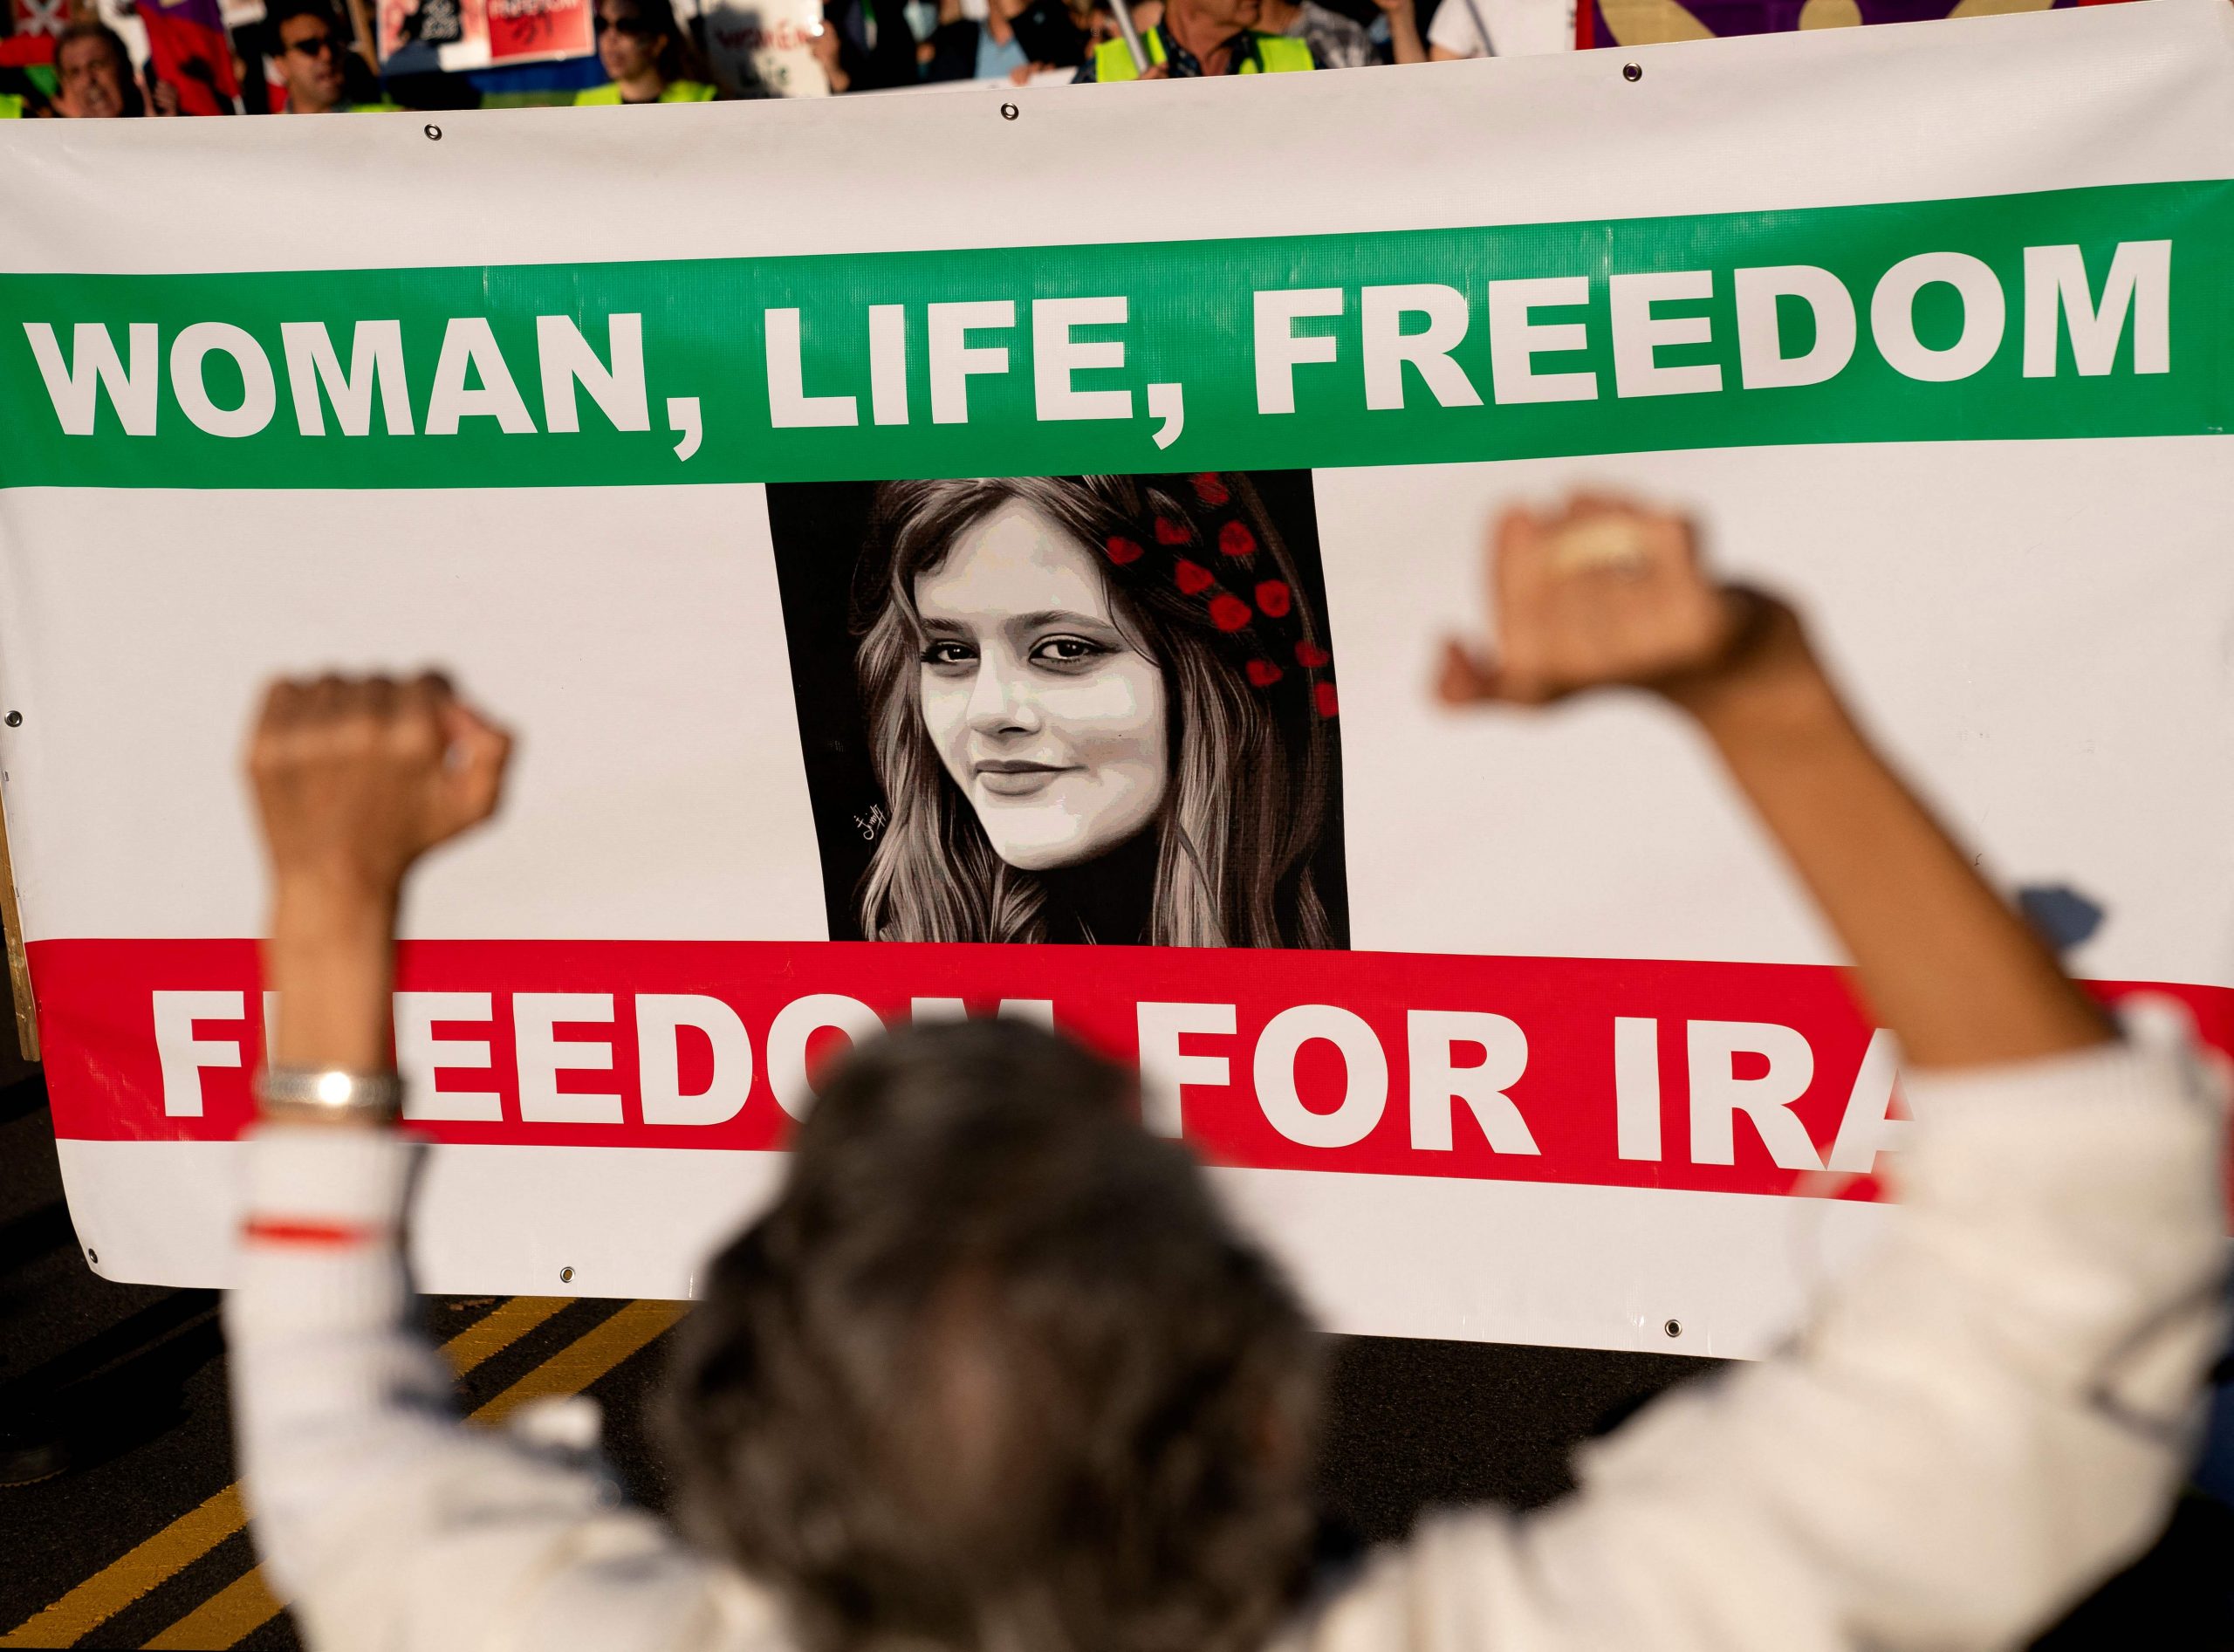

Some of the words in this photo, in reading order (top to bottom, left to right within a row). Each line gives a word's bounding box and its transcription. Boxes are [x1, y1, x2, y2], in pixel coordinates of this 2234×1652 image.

[22, 312, 703, 463] WOMAN,
[764, 295, 1185, 451] LIFE,
[1253, 239, 2173, 415] FREEDOM
[152, 990, 1055, 1126] FEEDO
[1136, 1001, 1542, 1156] FOR
[1614, 1016, 1919, 1174] IRA
